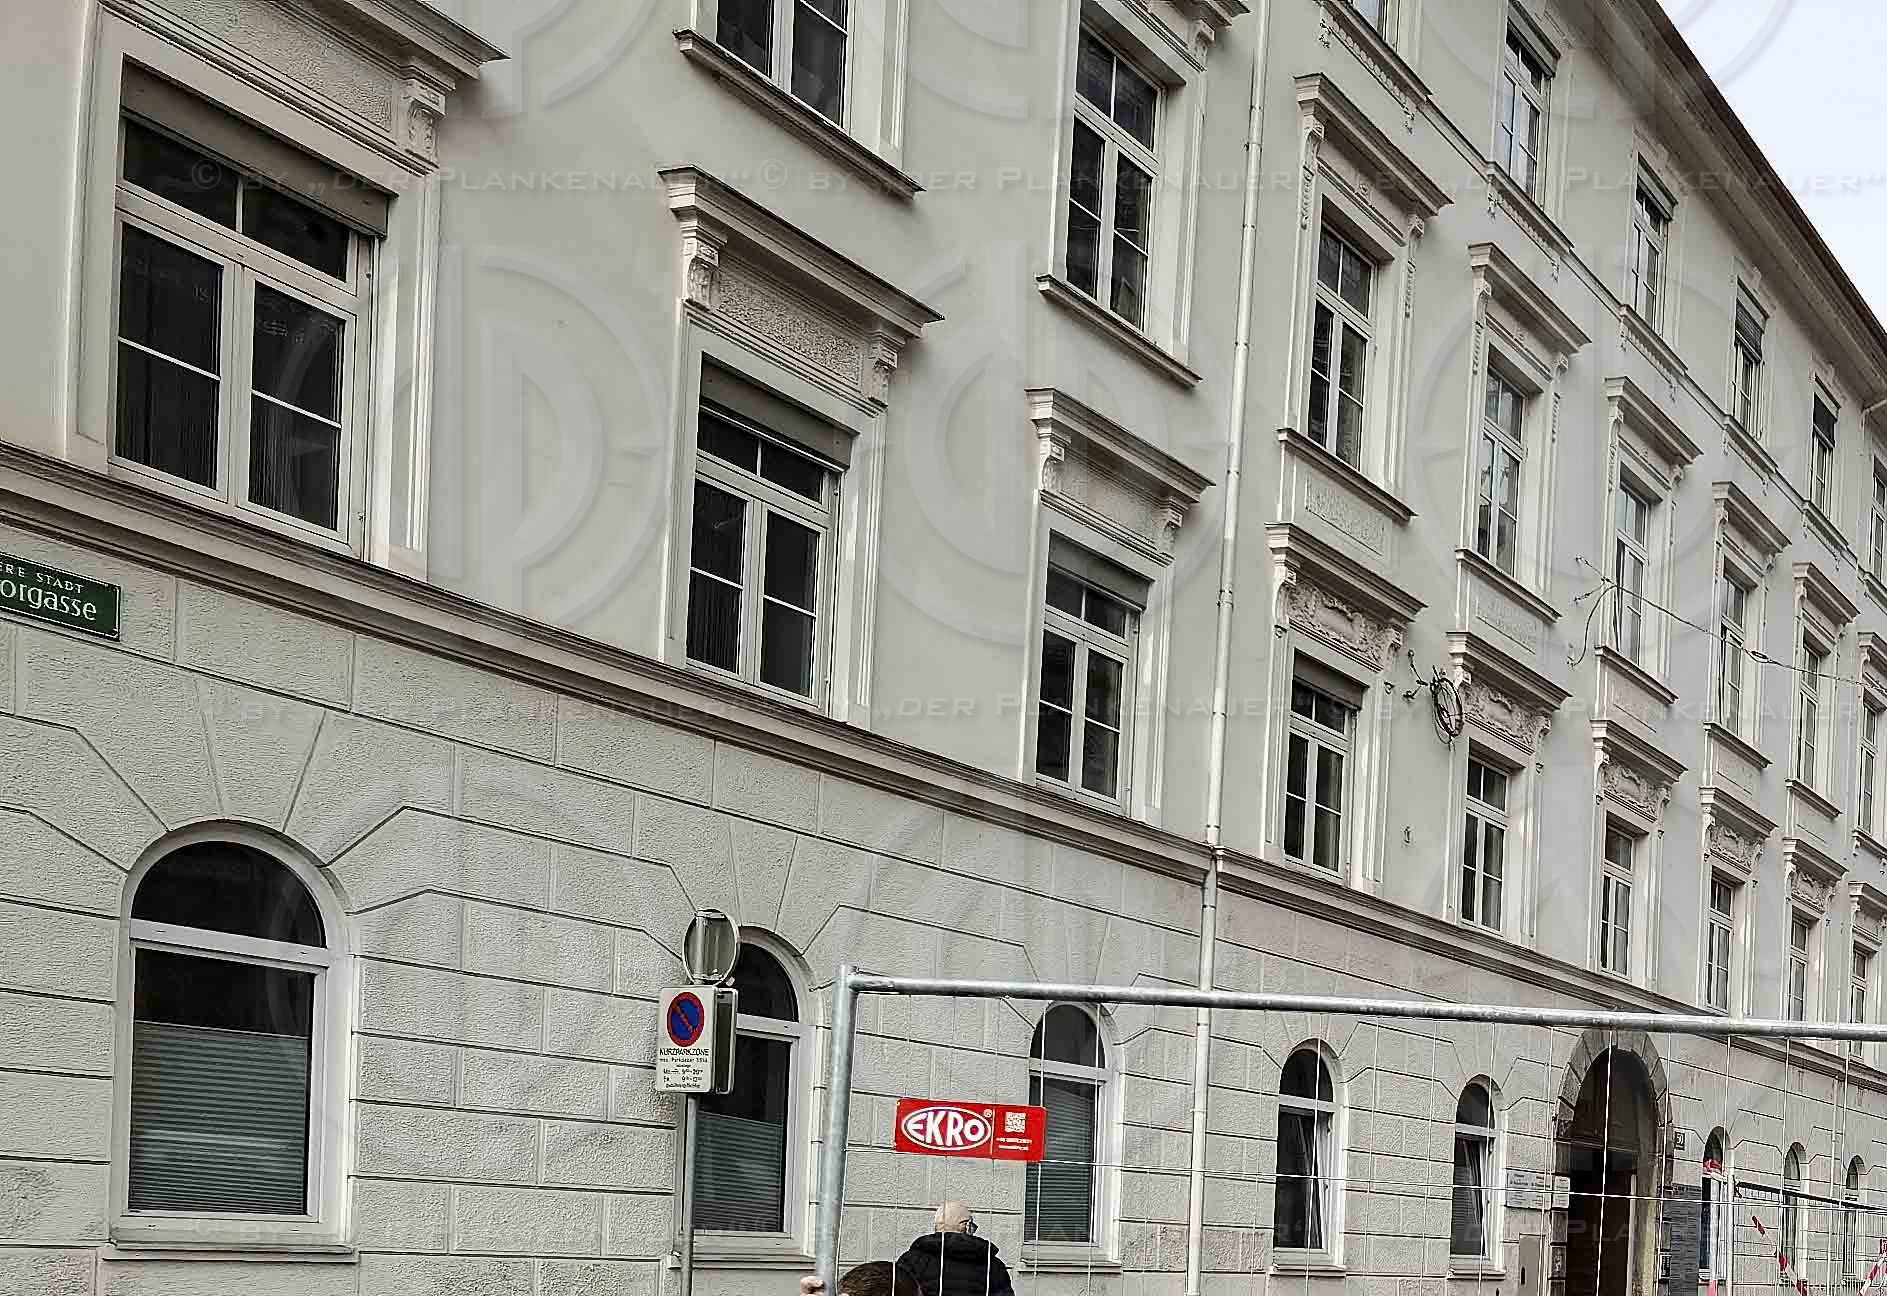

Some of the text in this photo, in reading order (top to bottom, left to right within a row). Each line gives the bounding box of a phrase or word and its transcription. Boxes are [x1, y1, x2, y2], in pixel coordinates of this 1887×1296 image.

[0, 580, 97, 620] orgasse
[36, 573, 84, 593] STADT
[906, 1110, 986, 1147] EKRO
